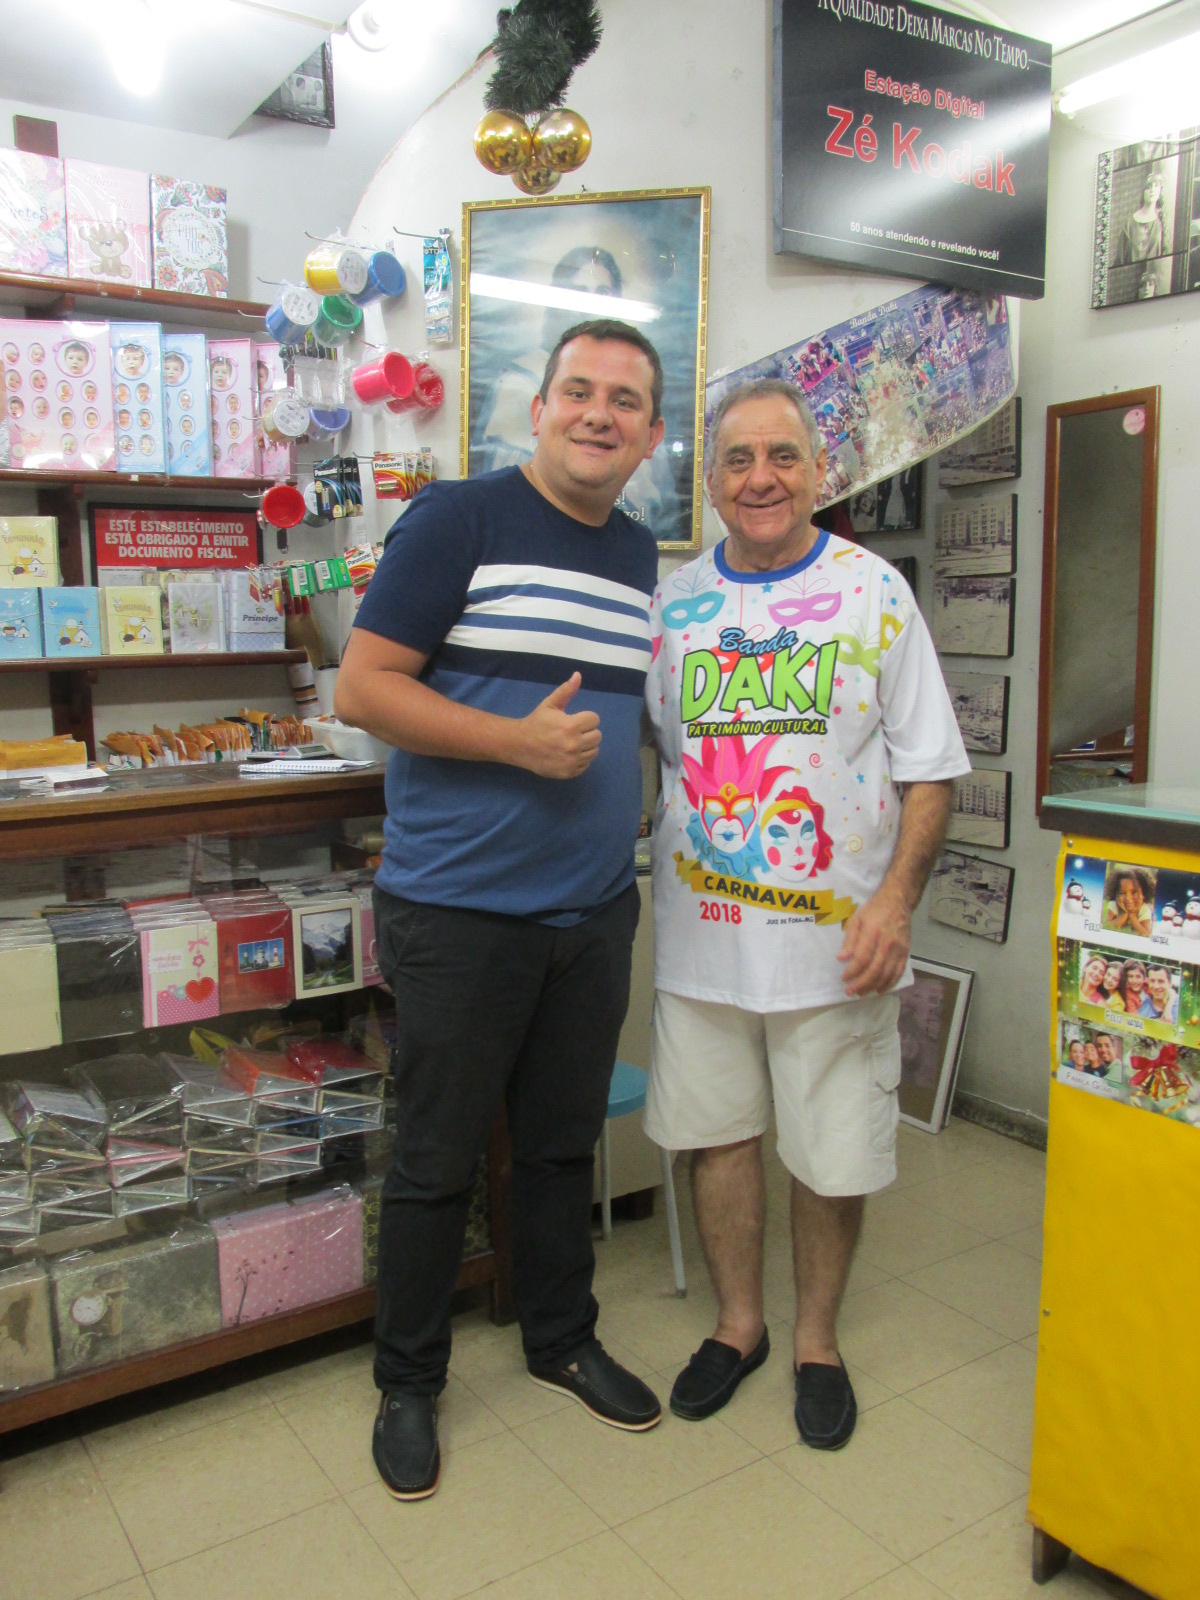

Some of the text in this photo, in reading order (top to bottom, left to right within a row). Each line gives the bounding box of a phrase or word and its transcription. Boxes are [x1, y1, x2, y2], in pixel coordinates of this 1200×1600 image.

[897, 5, 929, 40] DEIXA
[931, 16, 972, 54] MARCAS
[974, 30, 992, 59] NO
[864, 69, 985, 120] Estação Digital
[825, 105, 1015, 196] Zé Kodak
[850, 221, 999, 261] 50 anos atendendo e revelando você!
[850, 311, 878, 329] Banda
[374, 461, 403, 469] Panasonic
[105, 530, 249, 547] ESTÁ OBRIGADO A EMITIR
[109, 519, 244, 534] ESTE ESTABELECIMENTO
[118, 546, 238, 559] DOCUMENTO FISCAL.
[348, 552, 372, 566] Panasonic
[719, 626, 798, 655] Banda
[681, 640, 839, 723] DAKI
[763, 717, 828, 734] CULTURAL
[704, 875, 820, 911] CARNAVAL
[700, 901, 742, 925] 2018
